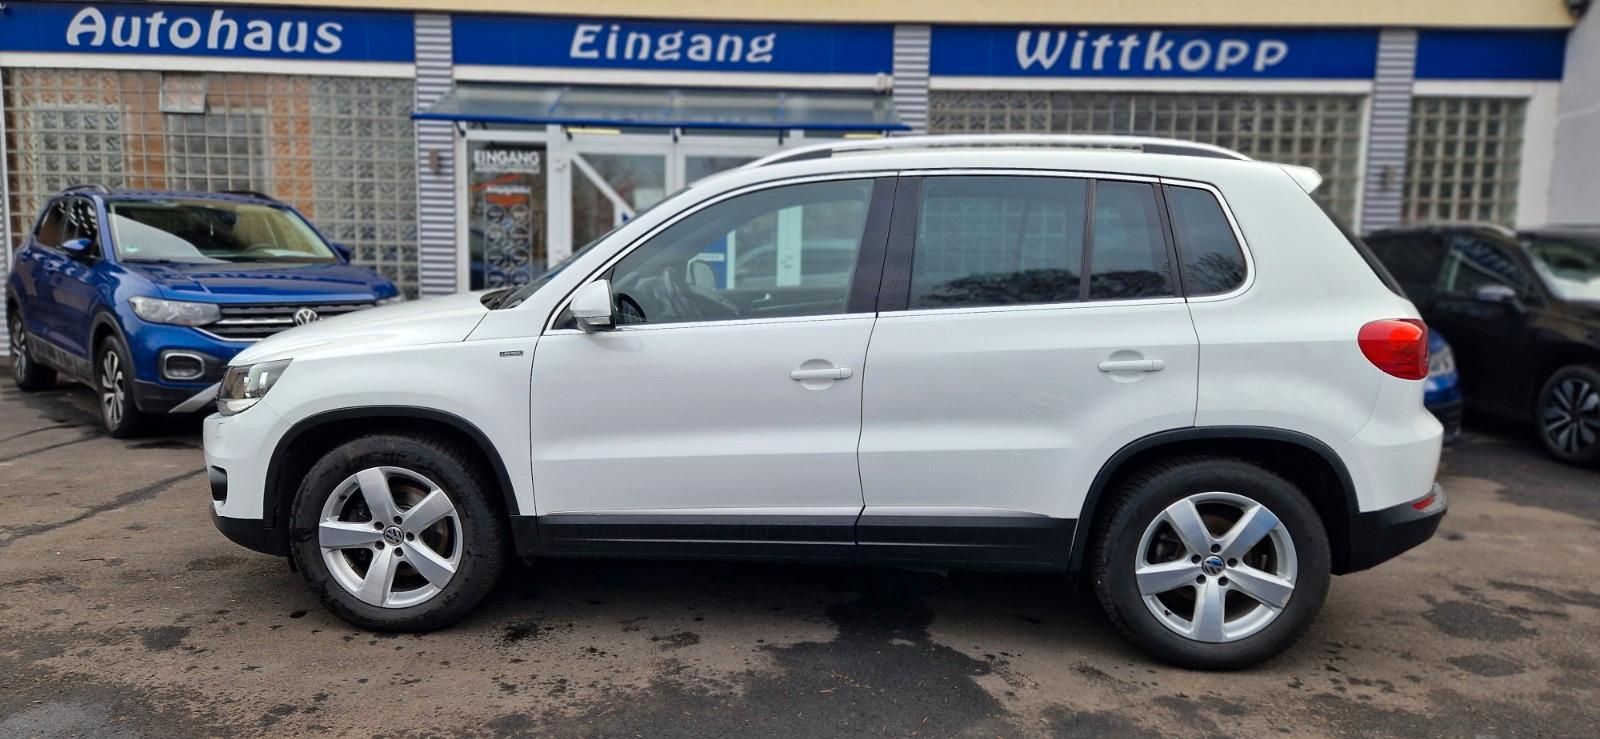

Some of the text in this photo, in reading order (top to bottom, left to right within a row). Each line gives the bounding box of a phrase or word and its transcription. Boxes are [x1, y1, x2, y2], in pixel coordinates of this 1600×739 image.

[66, 6, 344, 55] Autohaus
[569, 23, 777, 63] Eingang
[1015, 30, 1289, 72] Wittkopp
[473, 150, 540, 167] EINGANG
